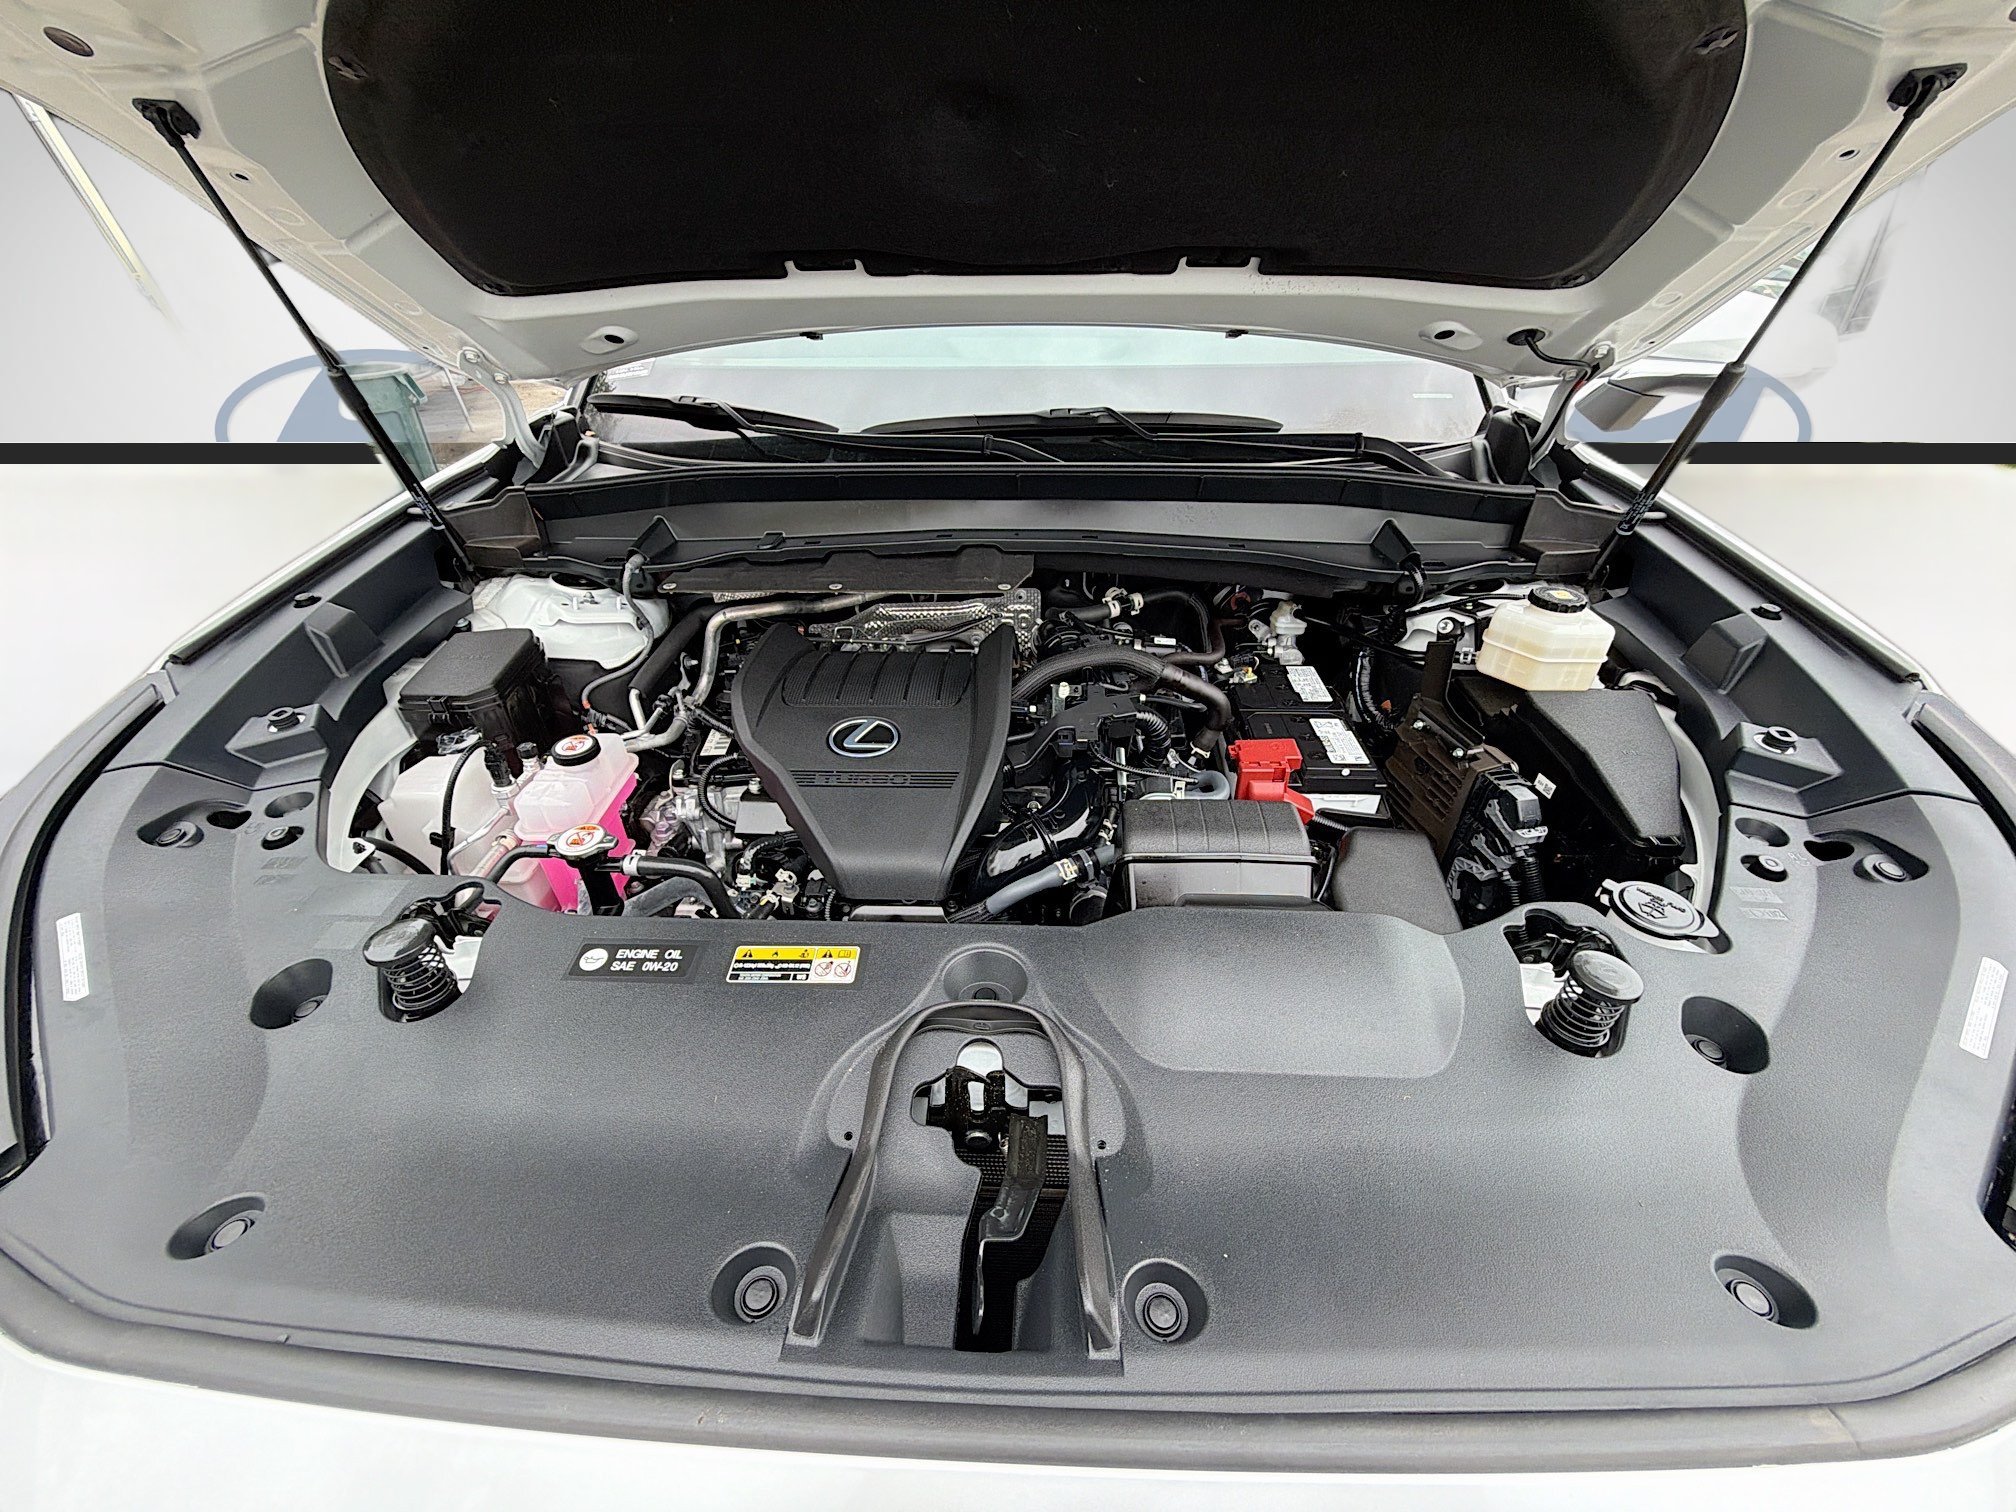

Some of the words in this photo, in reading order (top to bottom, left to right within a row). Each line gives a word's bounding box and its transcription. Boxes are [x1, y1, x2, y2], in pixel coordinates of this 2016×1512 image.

[817, 773, 909, 785] TURBO
[615, 949, 660, 959] ENGINE
[664, 949, 683, 960] OIL
[610, 961, 637, 971] SAE
[641, 961, 679, 972] 0W-20
